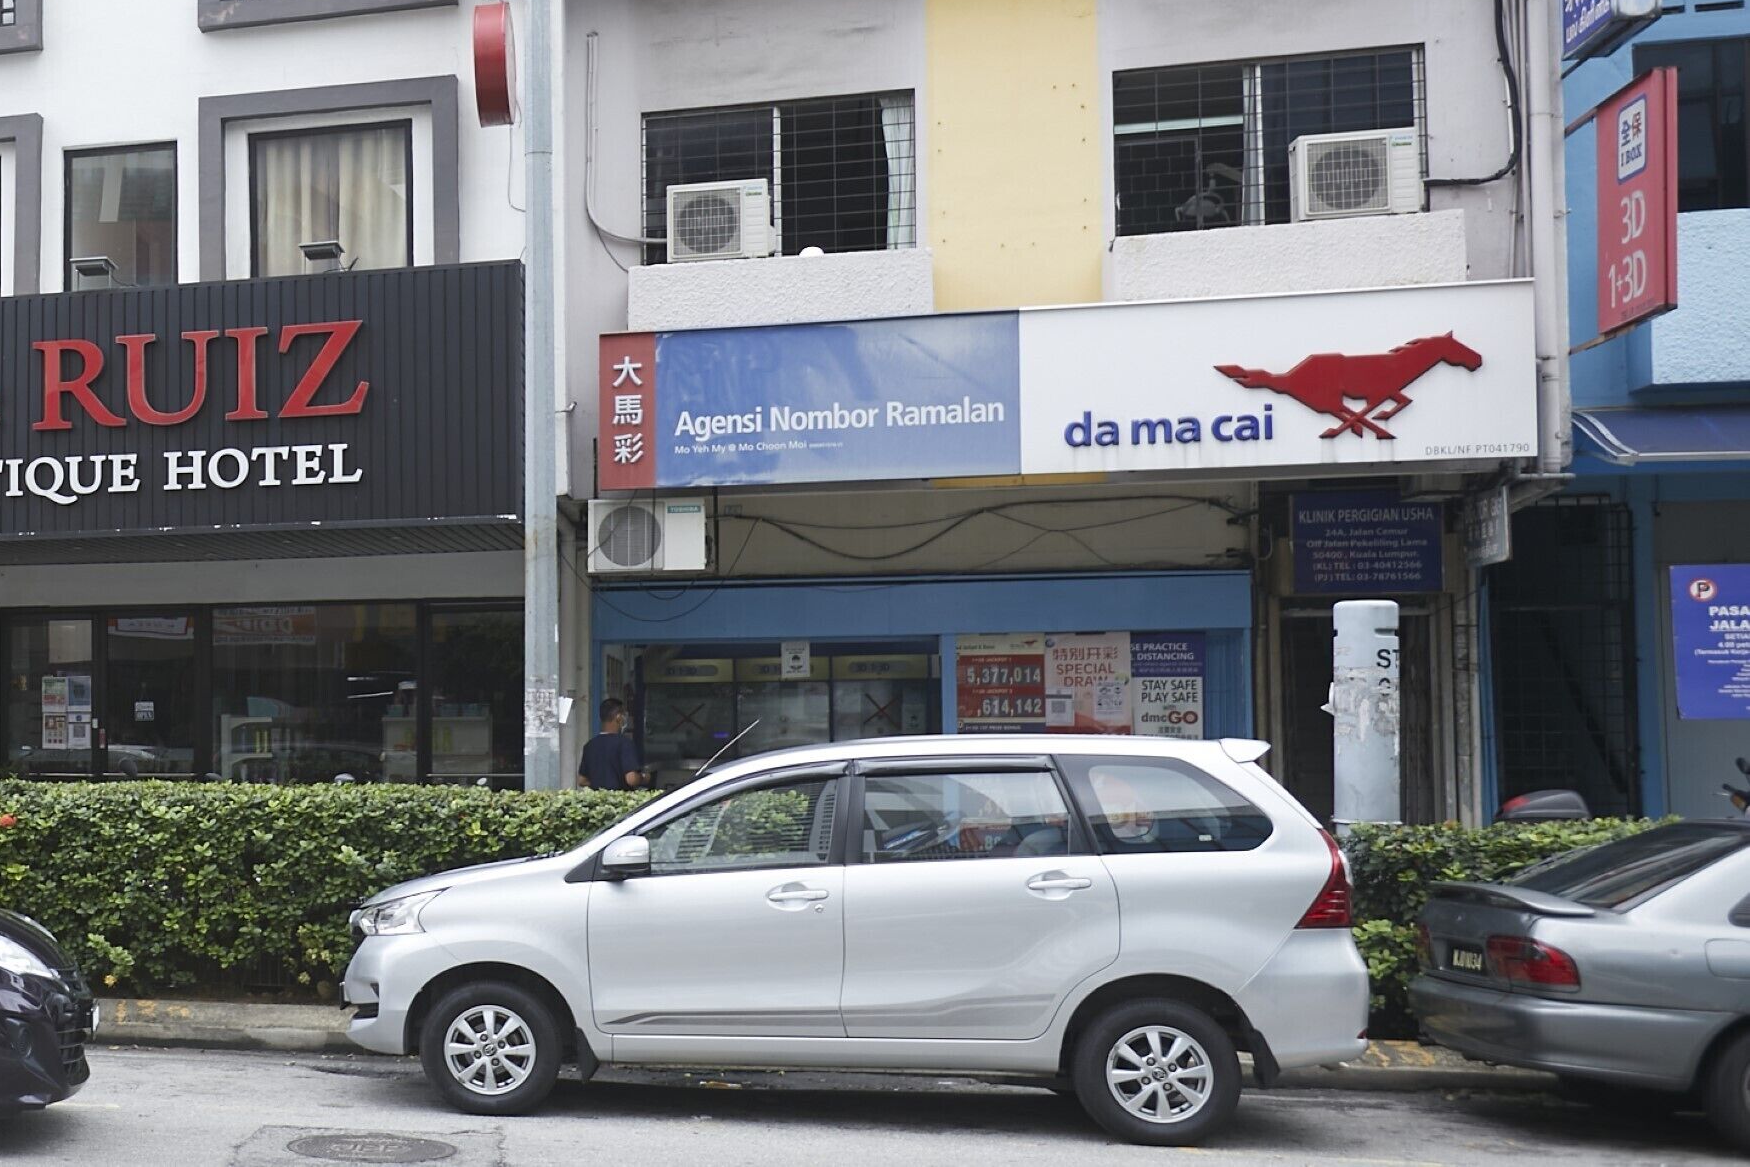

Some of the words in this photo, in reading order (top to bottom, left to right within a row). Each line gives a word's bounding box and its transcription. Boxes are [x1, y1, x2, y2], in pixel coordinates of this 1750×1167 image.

[1620, 189, 1647, 245] 3D
[1609, 249, 1647, 309] 1+3D
[32, 320, 370, 431] RUIZ
[612, 355, 644, 464] 大馬彩
[675, 406, 762, 442] Agensi
[770, 402, 879, 432] Nombor
[886, 395, 1005, 427] Ramalan
[1063, 410, 1120, 448] da
[1130, 416, 1202, 445] ma
[1210, 403, 1274, 442] cai
[675, 445, 690, 454] Mo
[711, 443, 726, 454] My
[738, 443, 754, 452] Mo
[1425, 444, 1472, 456] DBKL/NF
[1475, 442, 1530, 454] PT041790
[163, 443, 363, 491] HOTEL
[1299, 510, 1336, 524] KLINIK
[1338, 508, 1398, 523] PERGIGIAN
[1401, 507, 1434, 521] USHA
[1143, 643, 1188, 652] PRACTICE
[1137, 652, 1195, 661] DISTANCING
[966, 665, 1041, 686] 5,377,014
[1056, 663, 1115, 676] SPECIAL
[1141, 680, 1168, 690] STAY
[1171, 680, 1197, 690] SAFE
[1141, 692, 1169, 703] PLAY
[1172, 692, 1198, 703] SAFE
[1141, 711, 1198, 724] dmcGO
